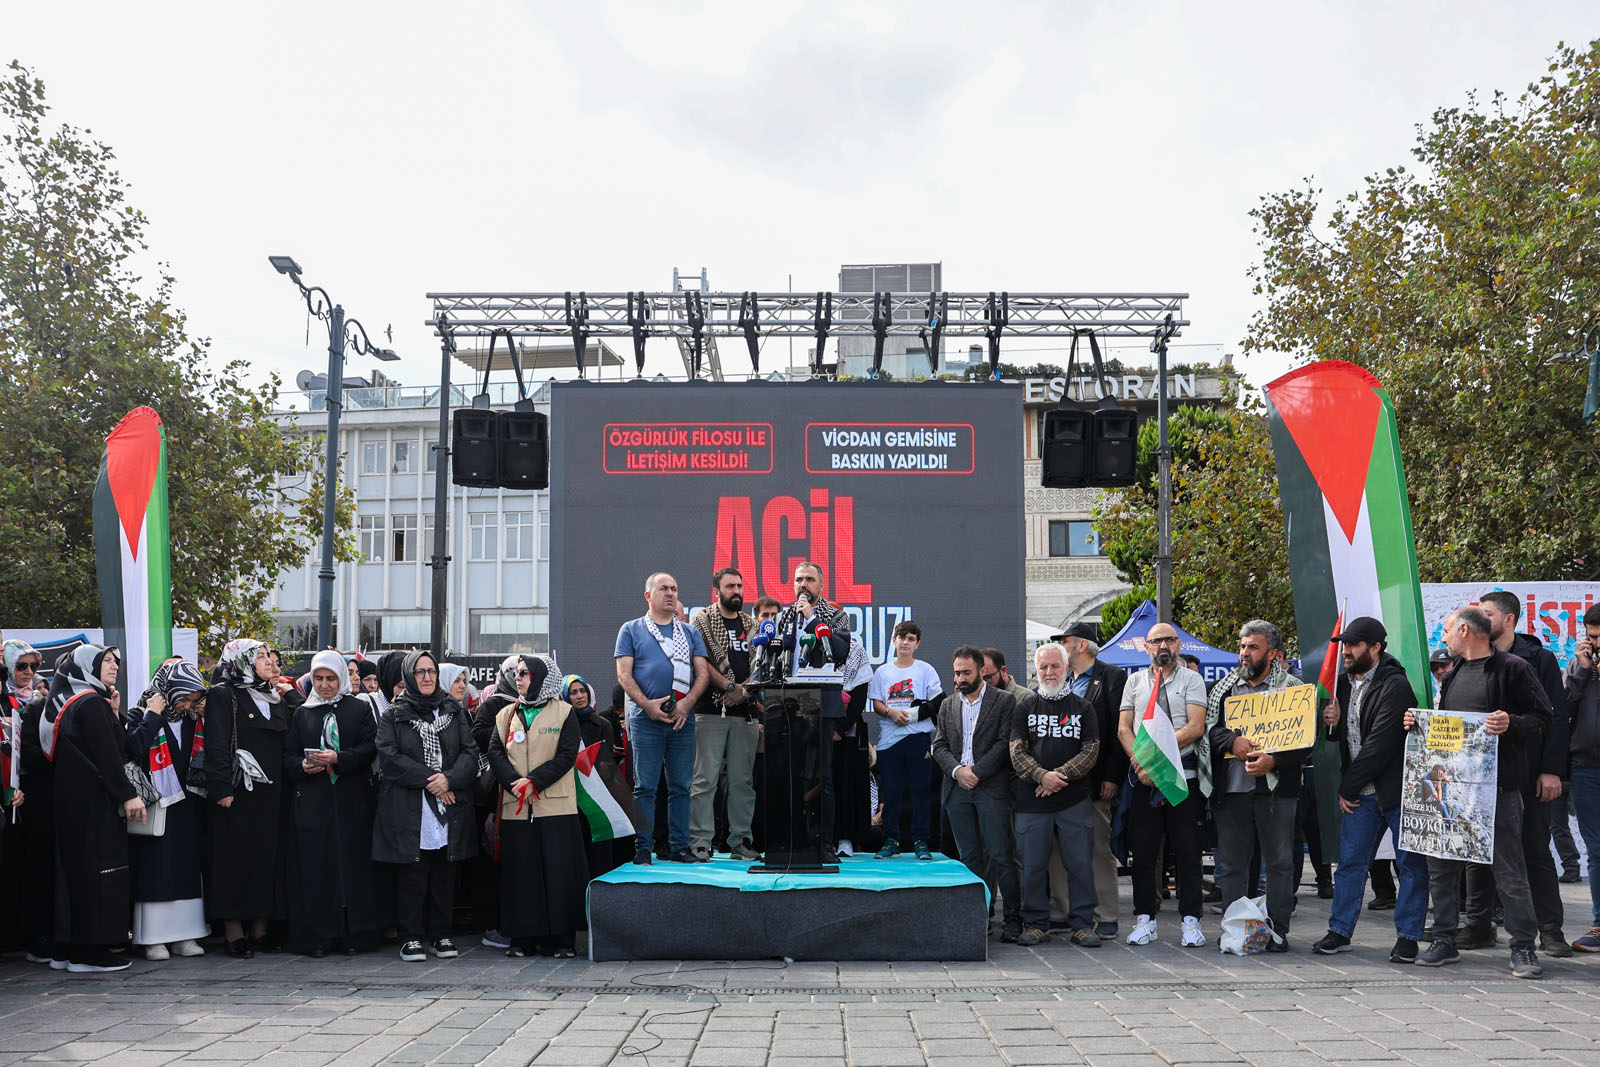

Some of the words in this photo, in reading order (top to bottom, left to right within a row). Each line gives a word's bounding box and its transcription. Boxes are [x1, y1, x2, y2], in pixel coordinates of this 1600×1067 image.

[1002, 374, 1197, 403] ESTORAN
[609, 428, 689, 447] ÖZGÜRLÜK
[692, 427, 742, 446] FİLOSU
[746, 427, 766, 446] İLE
[822, 427, 881, 447] VİCDAN
[884, 427, 957, 447] GEMİSİNE
[626, 449, 687, 472] İLETİŞİM
[690, 449, 749, 469] KESİLDİ!
[831, 453, 885, 470] BASKIN
[887, 453, 948, 470] YAPILDI!
[711, 488, 873, 604] ACİL
[469, 667, 494, 682] AFE
